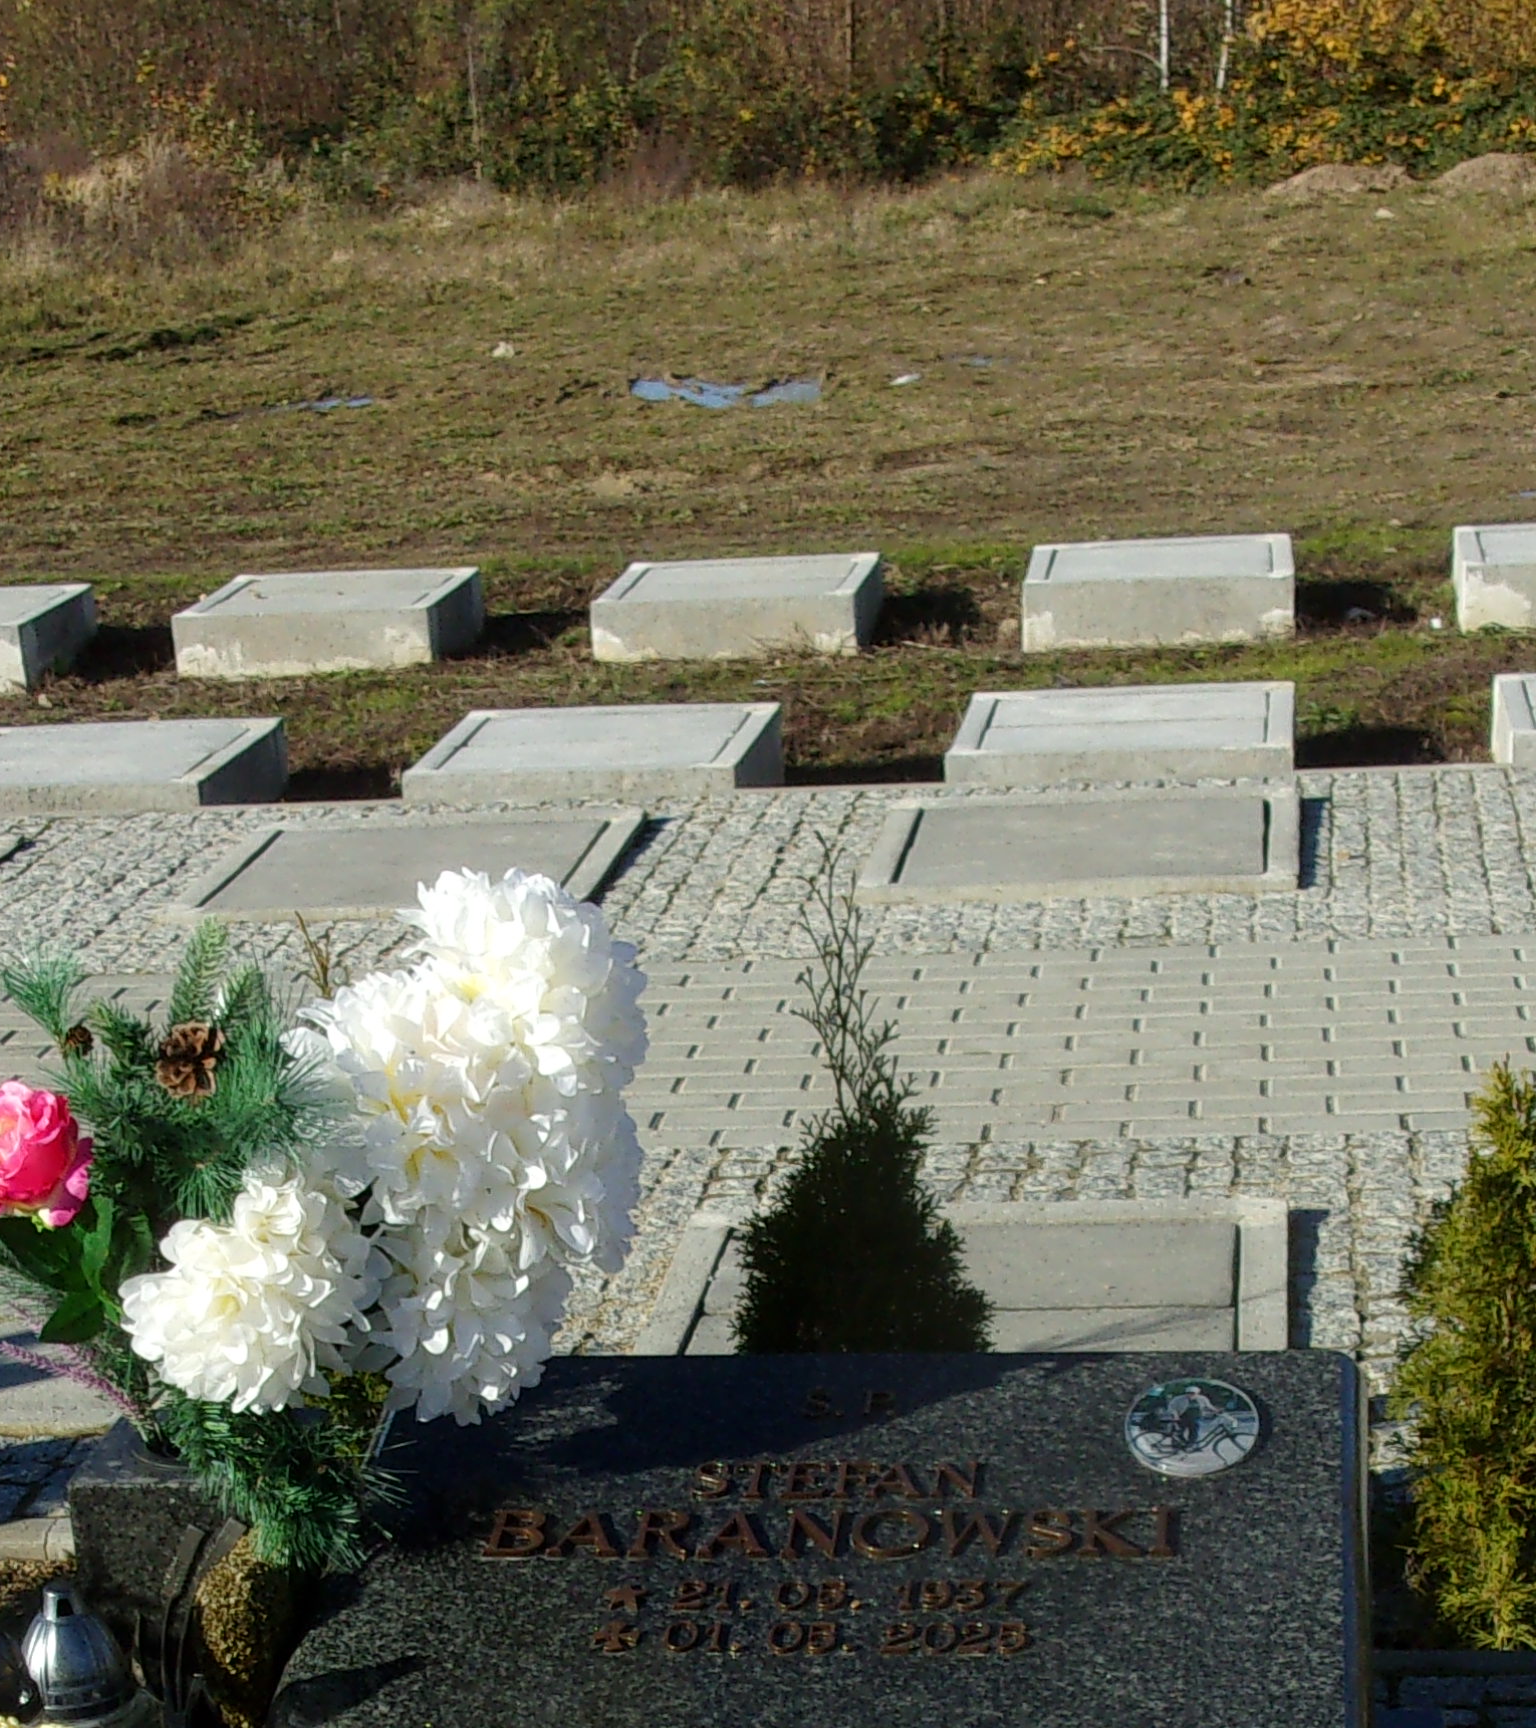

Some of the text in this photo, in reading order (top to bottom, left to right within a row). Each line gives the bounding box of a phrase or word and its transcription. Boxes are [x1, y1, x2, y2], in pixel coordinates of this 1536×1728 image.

[690, 1459, 987, 1501] STEFAN
[480, 1506, 1181, 1561] BARANOWSKI
[671, 1578, 753, 1613] 21.
[896, 1577, 1031, 1613] 1937
[664, 1619, 743, 1656] 01.
[878, 1620, 1029, 1656] 2025
